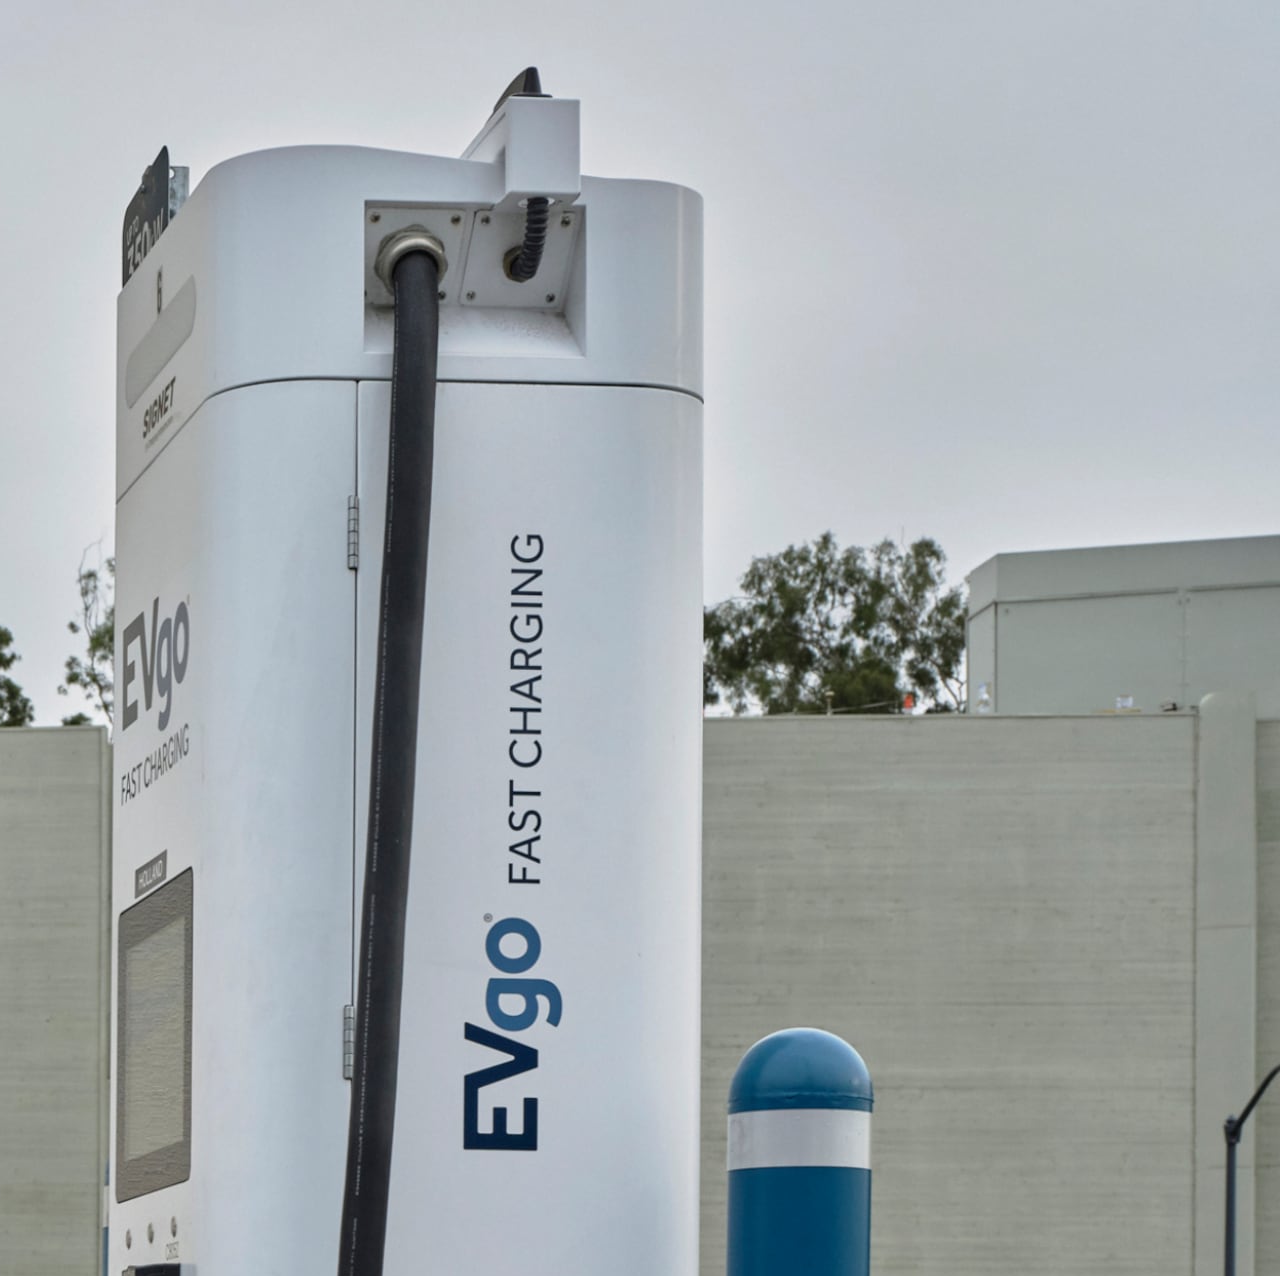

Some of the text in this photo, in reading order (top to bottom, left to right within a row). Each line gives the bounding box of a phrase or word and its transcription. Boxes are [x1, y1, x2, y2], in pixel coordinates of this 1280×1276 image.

[143, 376, 176, 438] SIGNET
[122, 597, 189, 732] EVgo
[121, 723, 190, 806] FAST CHARGING
[463, 533, 562, 1151] EVgo FAST CHARGING
